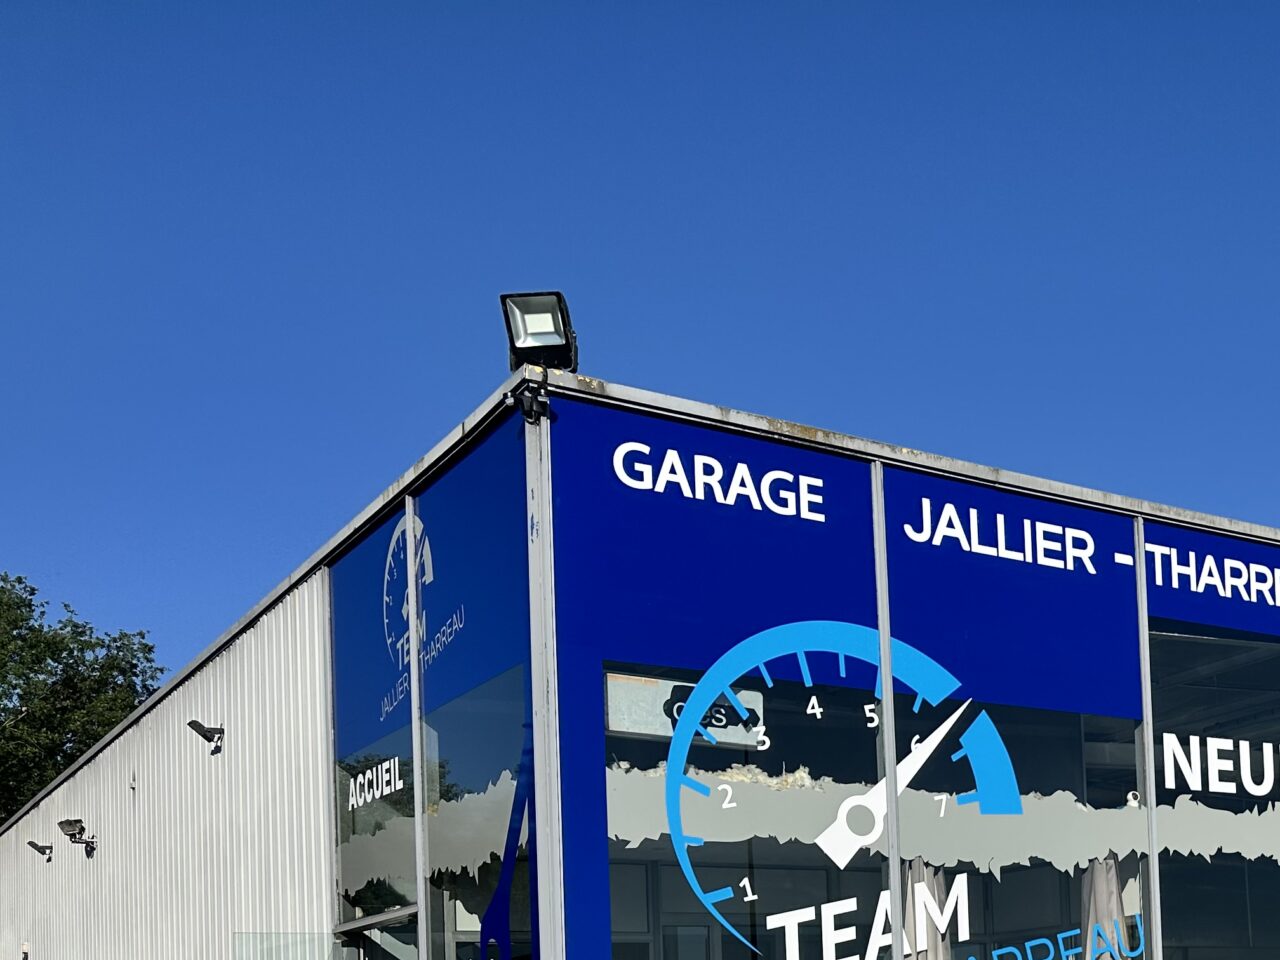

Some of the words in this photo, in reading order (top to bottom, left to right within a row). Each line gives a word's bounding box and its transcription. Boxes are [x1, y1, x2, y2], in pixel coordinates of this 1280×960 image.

[613, 442, 826, 523] GARAGE
[904, 497, 1097, 575] JALLIER
[396, 610, 427, 671] TEM
[379, 673, 410, 722] JALLIER
[419, 604, 465, 674] THARREAU
[805, 695, 824, 720] 4
[863, 703, 880, 729] 5
[752, 725, 771, 751] 3
[348, 756, 404, 811] ACCUEIL
[717, 783, 738, 810] 2
[933, 794, 949, 818] 7
[738, 877, 758, 902] 1
